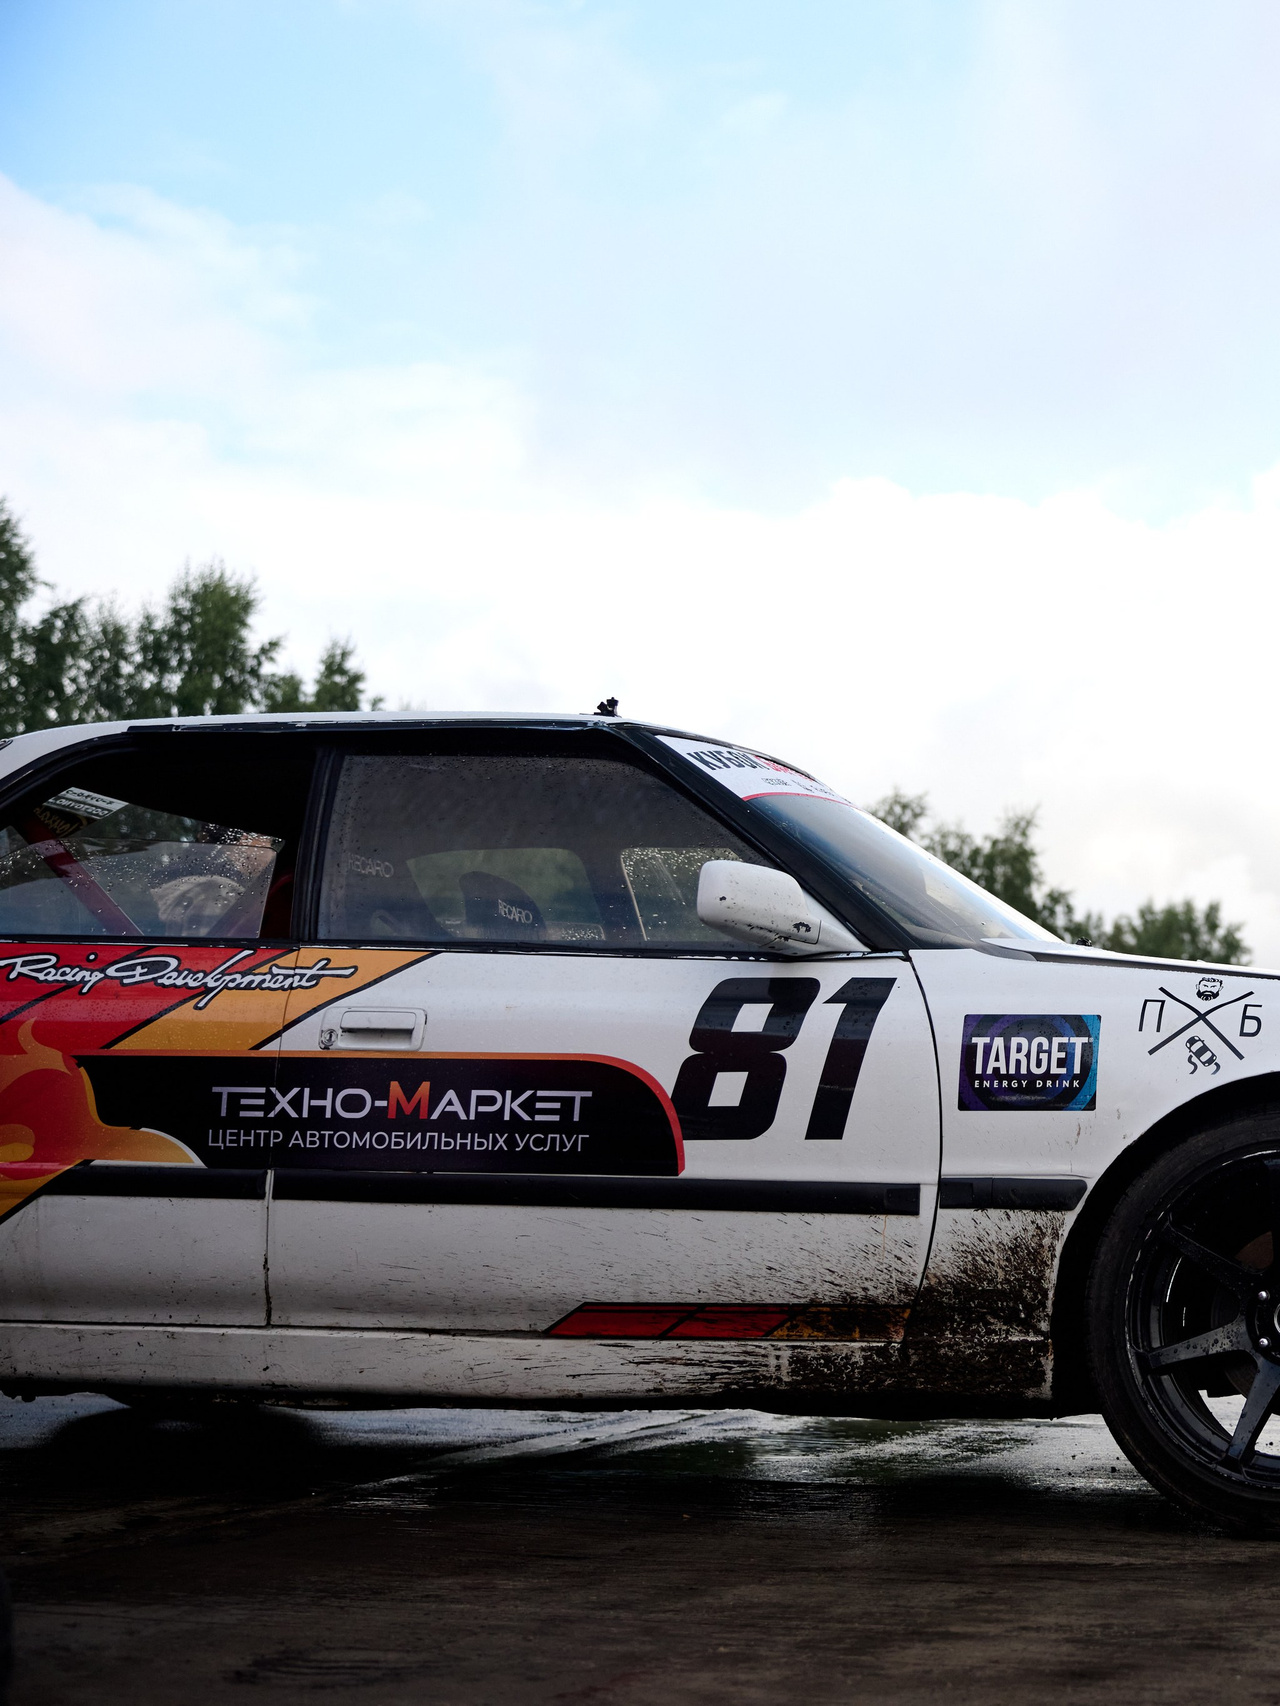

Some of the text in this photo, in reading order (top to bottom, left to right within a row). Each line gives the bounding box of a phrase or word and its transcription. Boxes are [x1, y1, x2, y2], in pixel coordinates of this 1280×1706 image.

[498, 899, 533, 924] RECARO
[0, 950, 356, 1008] Racing Development
[669, 977, 898, 1140] 81
[971, 1036, 1089, 1075] TARGET
[974, 1080, 1080, 1088] ENERGY DRINK
[208, 1129, 590, 1152] ЦЕНТР АВТОМОБИЛЬНЫХ УСЛУГ
